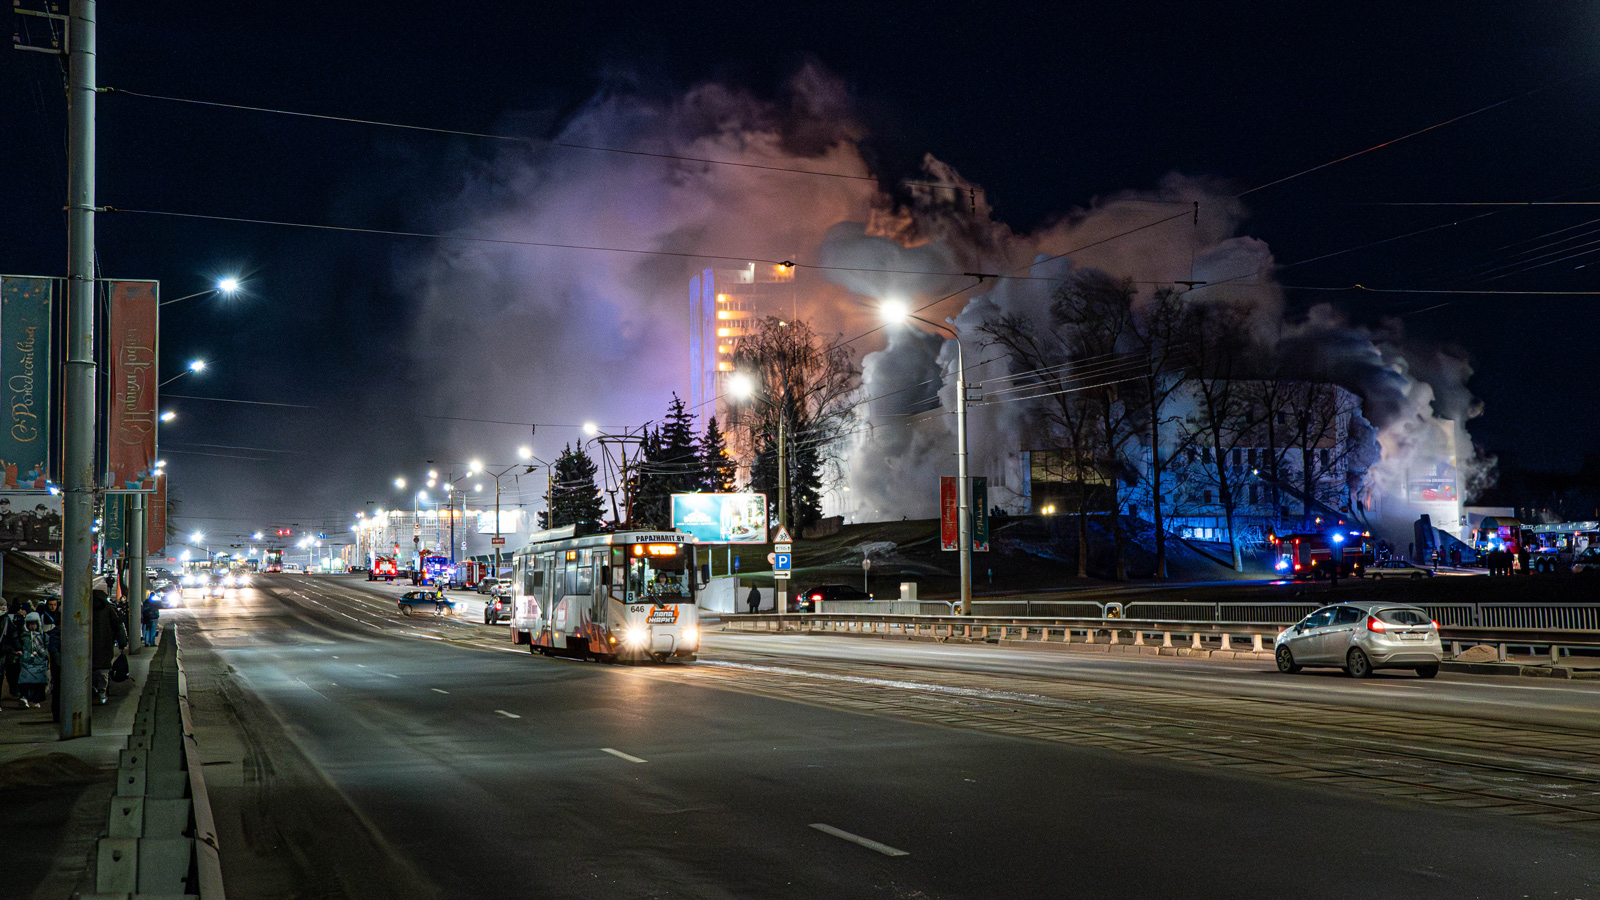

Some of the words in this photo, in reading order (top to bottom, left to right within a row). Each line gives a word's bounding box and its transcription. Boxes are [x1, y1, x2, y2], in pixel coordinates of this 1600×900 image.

[778, 555, 788, 568] P
[627, 592, 634, 601] 8
[630, 605, 645, 613] 646
